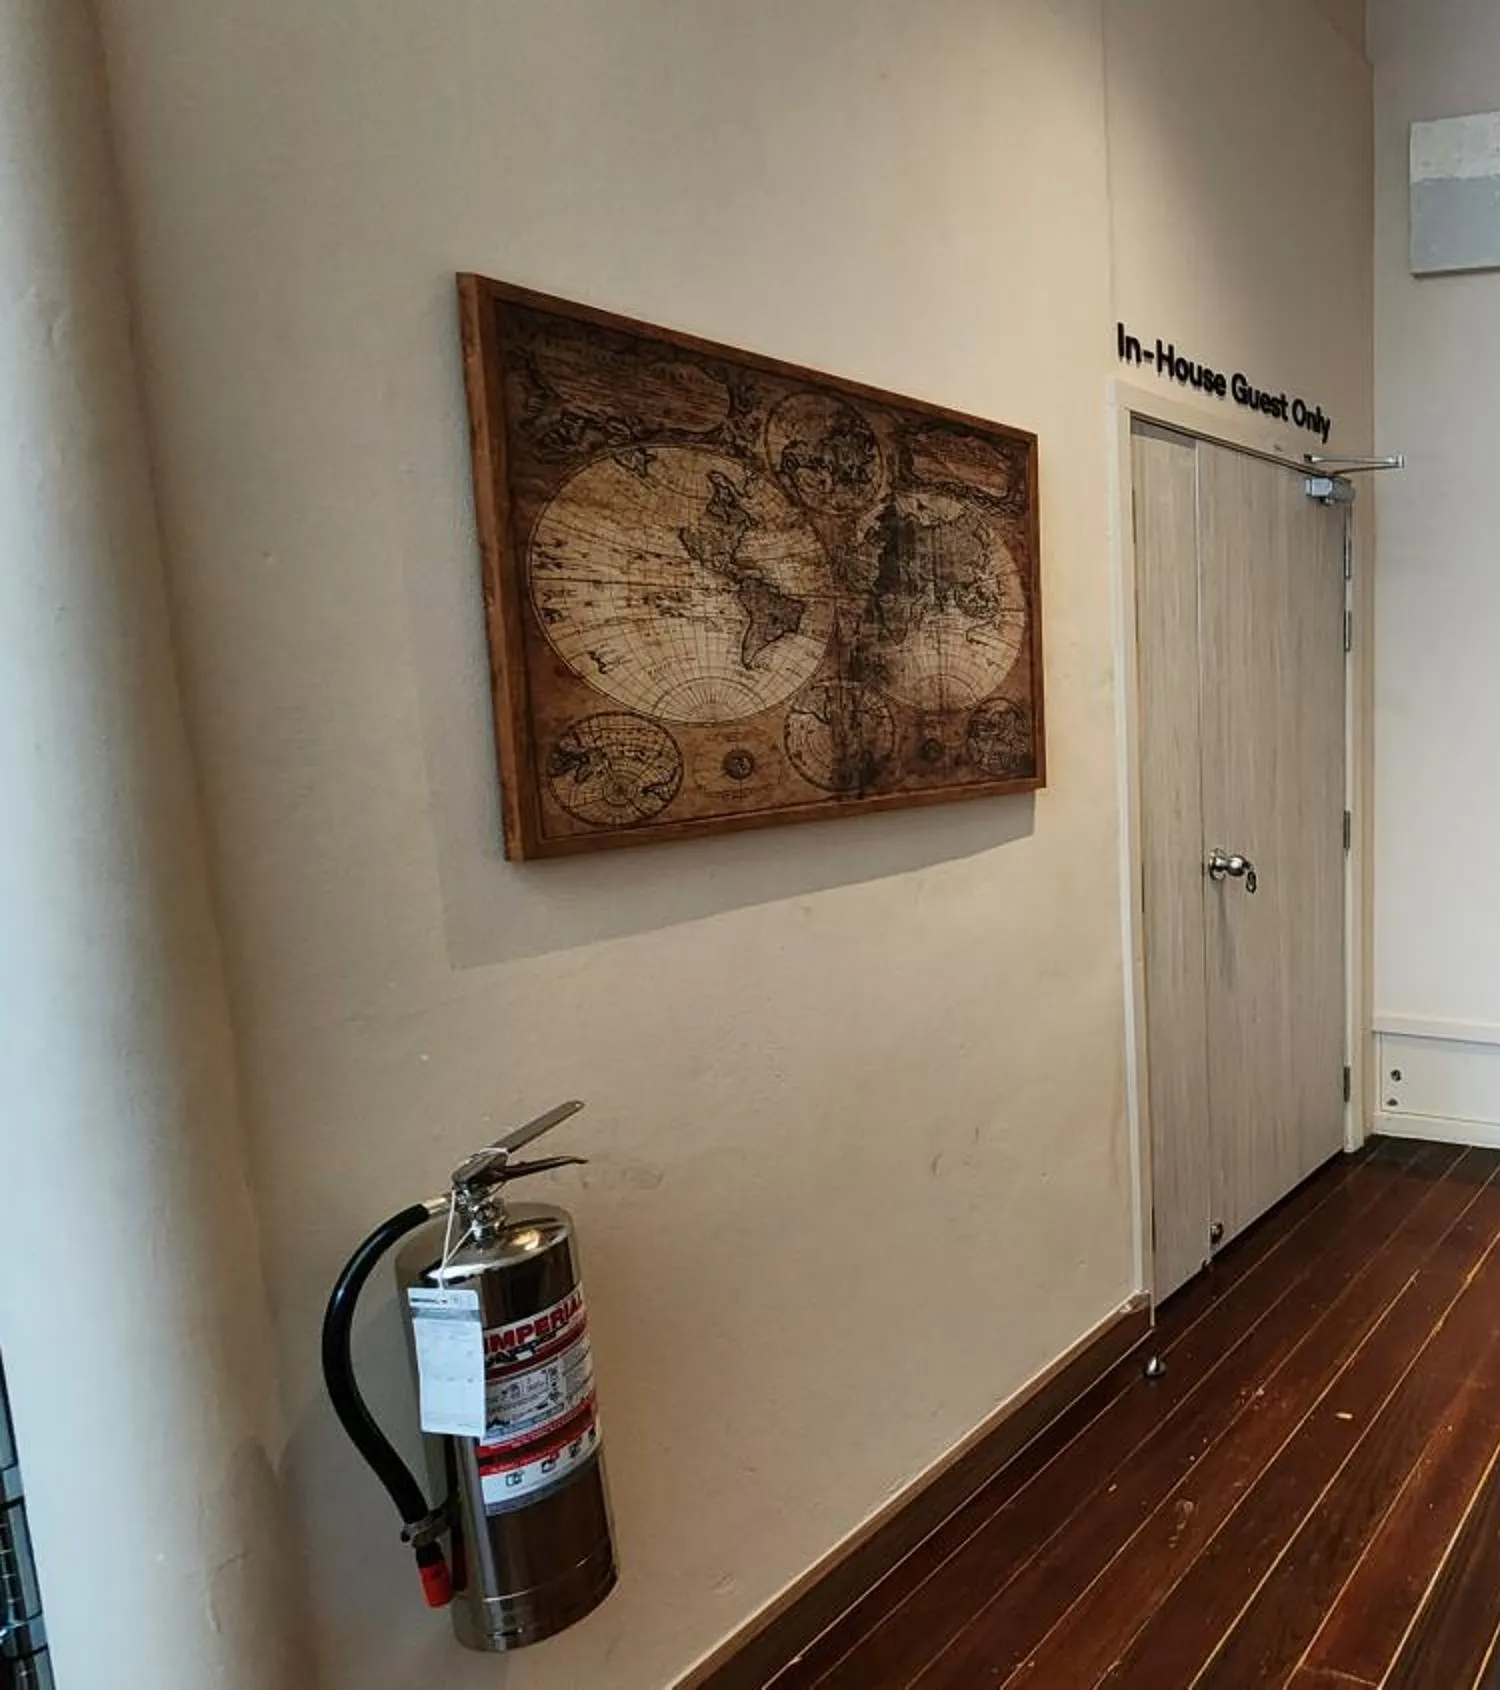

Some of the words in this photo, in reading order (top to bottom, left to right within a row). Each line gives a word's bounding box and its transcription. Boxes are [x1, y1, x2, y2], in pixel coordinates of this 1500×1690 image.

[1117, 322, 1227, 397] In-House
[1231, 373, 1289, 422] Guest
[1292, 399, 1331, 444] Only
